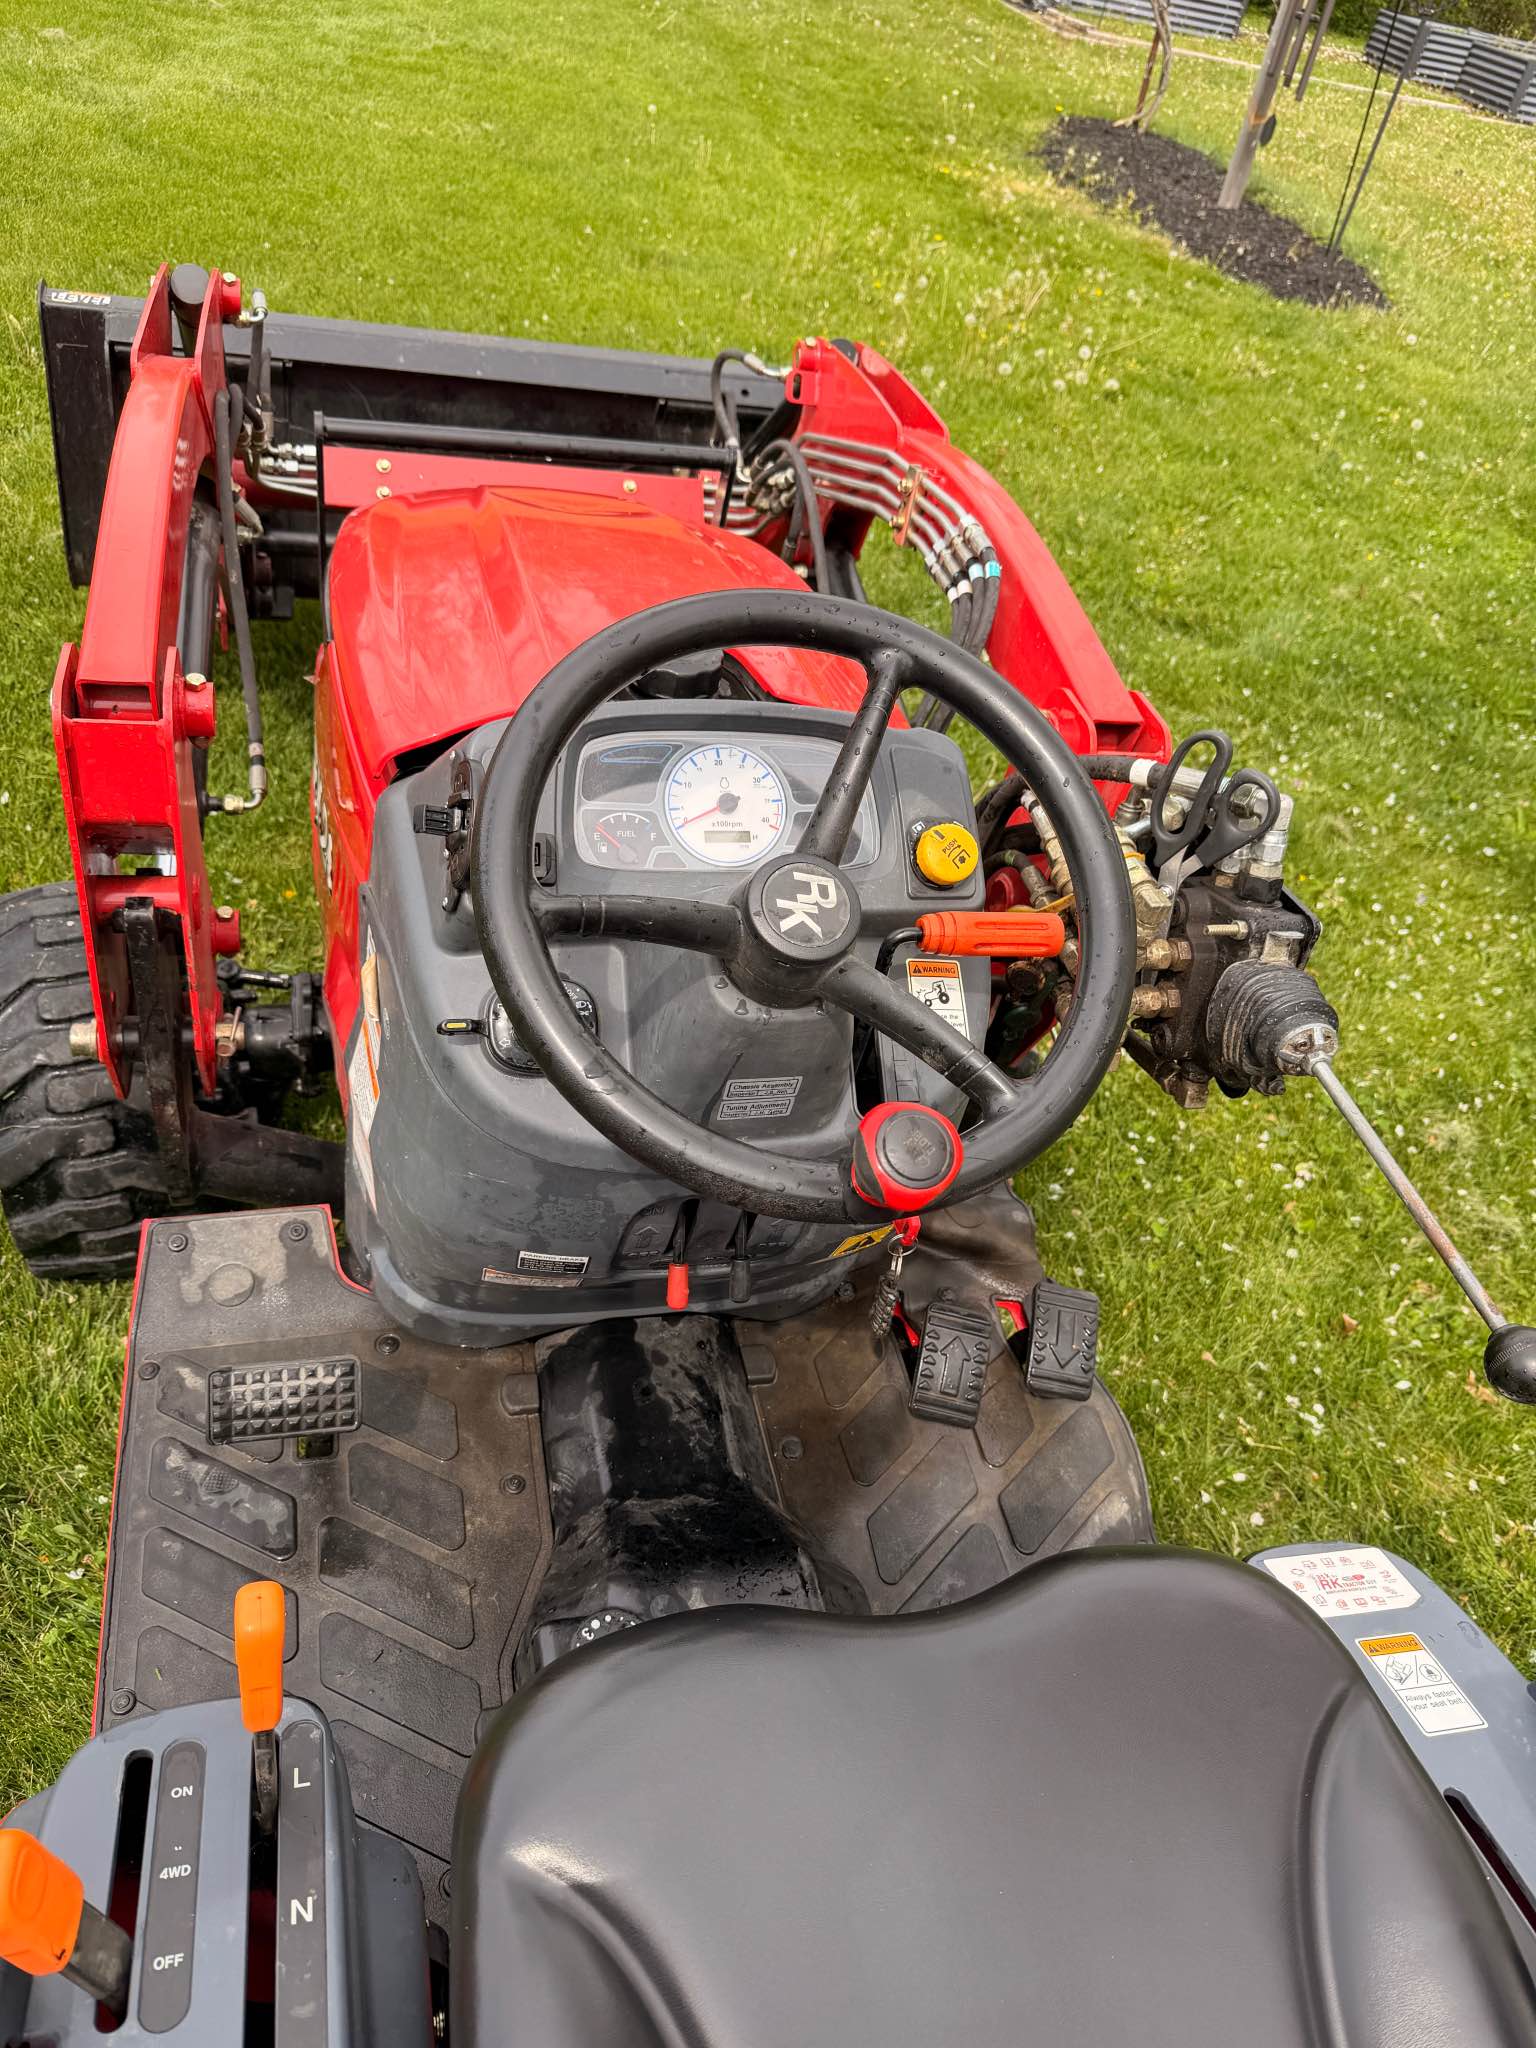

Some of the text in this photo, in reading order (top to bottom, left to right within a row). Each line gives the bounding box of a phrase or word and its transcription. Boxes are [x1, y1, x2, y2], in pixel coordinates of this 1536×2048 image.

[593, 833, 601, 841] E
[616, 830, 637, 838] FUEL
[650, 832, 657, 841] F
[942, 838, 958, 855] PUSH
[775, 871, 837, 940] RK
[922, 966, 955, 974] WARNING
[1376, 1638, 1419, 1651] WARNING
[293, 1767, 311, 1788] L
[171, 1785, 194, 1798] ON
[159, 1864, 192, 1880] 4WD
[290, 1897, 313, 1925] N
[153, 1953, 185, 1971] OFF
